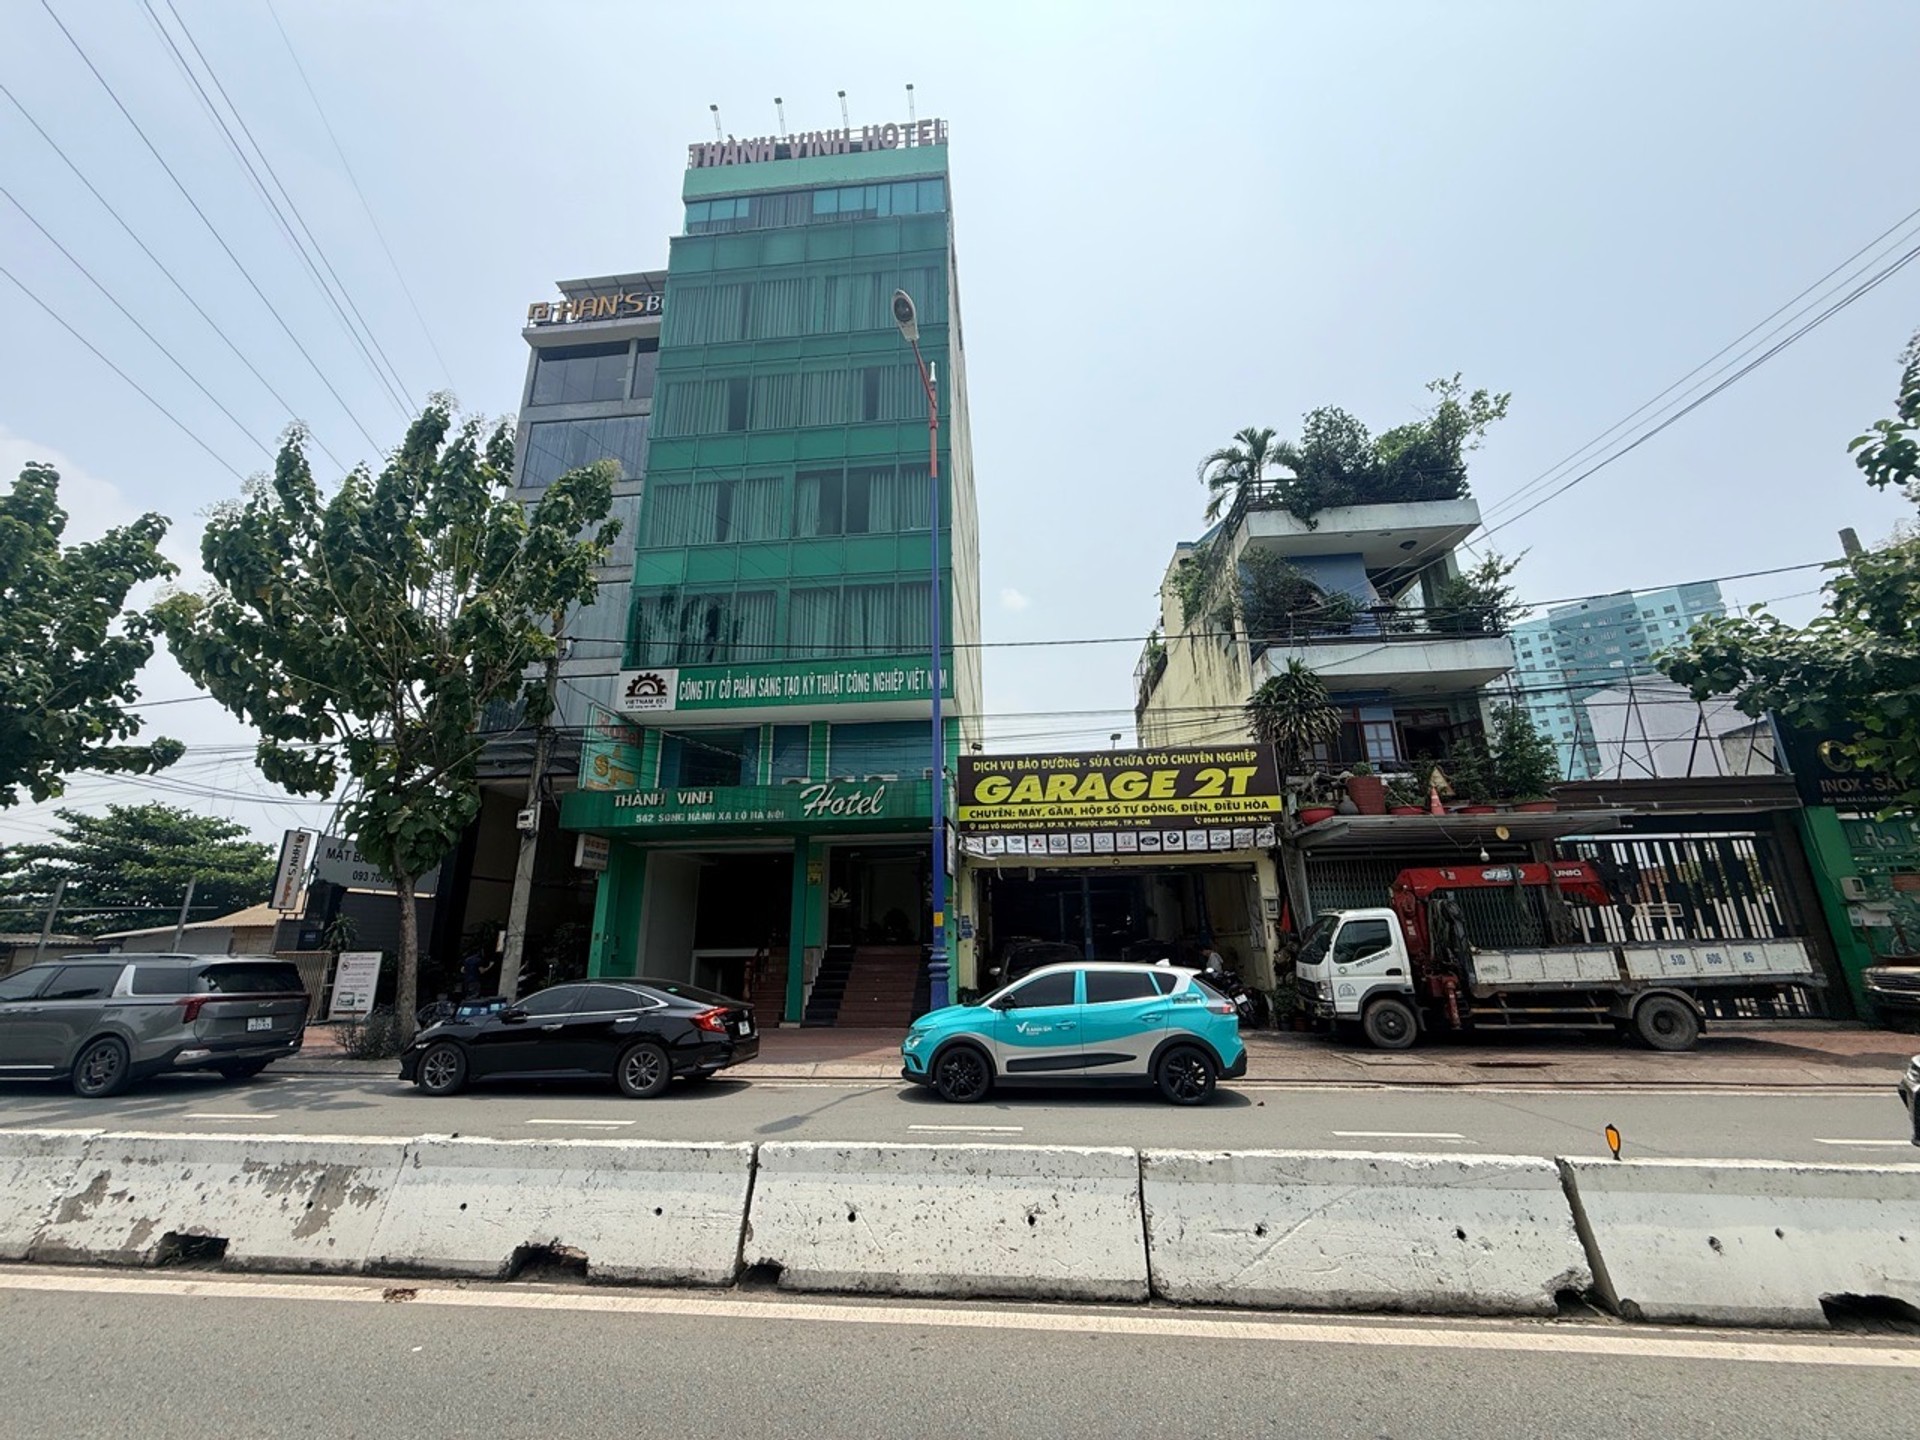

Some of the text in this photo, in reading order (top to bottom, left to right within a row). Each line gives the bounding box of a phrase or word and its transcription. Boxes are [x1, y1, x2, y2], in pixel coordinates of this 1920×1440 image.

[689, 118, 947, 168] THÀNH VINH HOTEL
[558, 292, 644, 320] HAN'S
[679, 678, 703, 700] CÔNG
[705, 680, 717, 700] TY
[719, 670, 732, 699] CỔ
[758, 673, 781, 697] SÁNG
[783, 676, 800, 699] TẠO
[816, 670, 845, 697] THUẬT
[846, 669, 870, 693] CÔNG
[873, 667, 905, 694] NGHIỆP
[906, 667, 926, 694] VIỆT
[928, 669, 947, 690] NM
[973, 761, 998, 773] DỊCH
[1000, 760, 1015, 772] VỤ
[1113, 754, 1144, 767] CHỮA
[1170, 751, 1214, 764] CHUYÊN
[1216, 749, 1257, 763] NGHIỆP
[974, 766, 1258, 804] GARAGE 2T
[1820, 778, 1861, 792] INOX
[614, 784, 885, 817] THÀNH VINH Hotel
[969, 807, 1015, 819] CHUYÊN:
[1018, 806, 1045, 817] MÁY,
[1080, 804, 1103, 817] HỘP
[1106, 803, 1121, 814] SỐ
[1123, 803, 1139, 815] TỰ
[1142, 802, 1178, 815] ĐỘNG,
[1244, 800, 1269, 809] HÒA
[658, 813, 685, 822] SONG
[352, 870, 369, 882] 093
